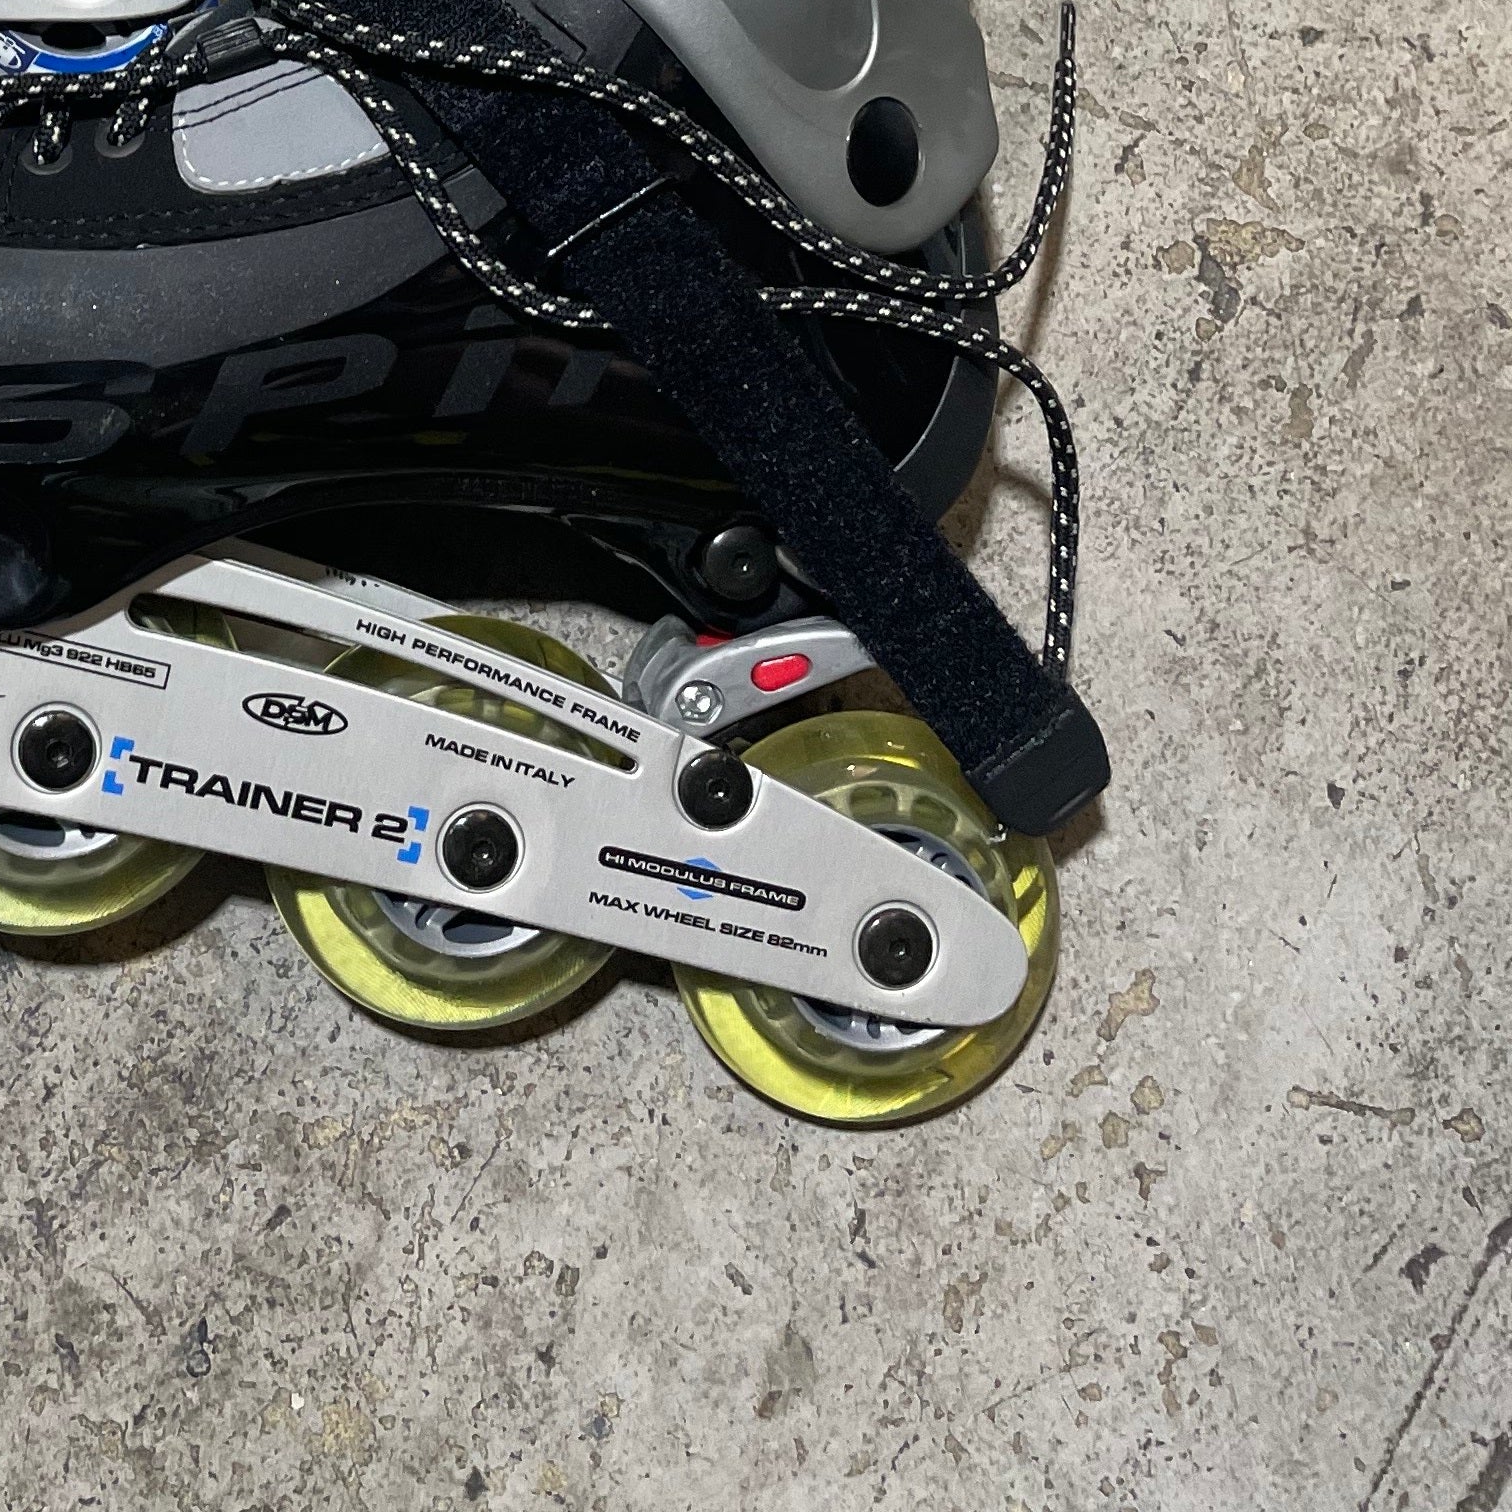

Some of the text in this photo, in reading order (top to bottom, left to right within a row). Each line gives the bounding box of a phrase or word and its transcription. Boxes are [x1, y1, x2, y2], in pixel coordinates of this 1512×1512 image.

[23, 638, 63, 657] Mg3
[66, 647, 103, 666] 922
[355, 618, 642, 743] HIGH PERFORMANCE FRAME
[424, 733, 576, 789] MADE IN ITALY
[128, 753, 409, 844] TRAINER 2
[605, 851, 801, 907] HI MODULUS FRAME
[588, 890, 829, 958] MAX WHEEL SIZE 82mm
